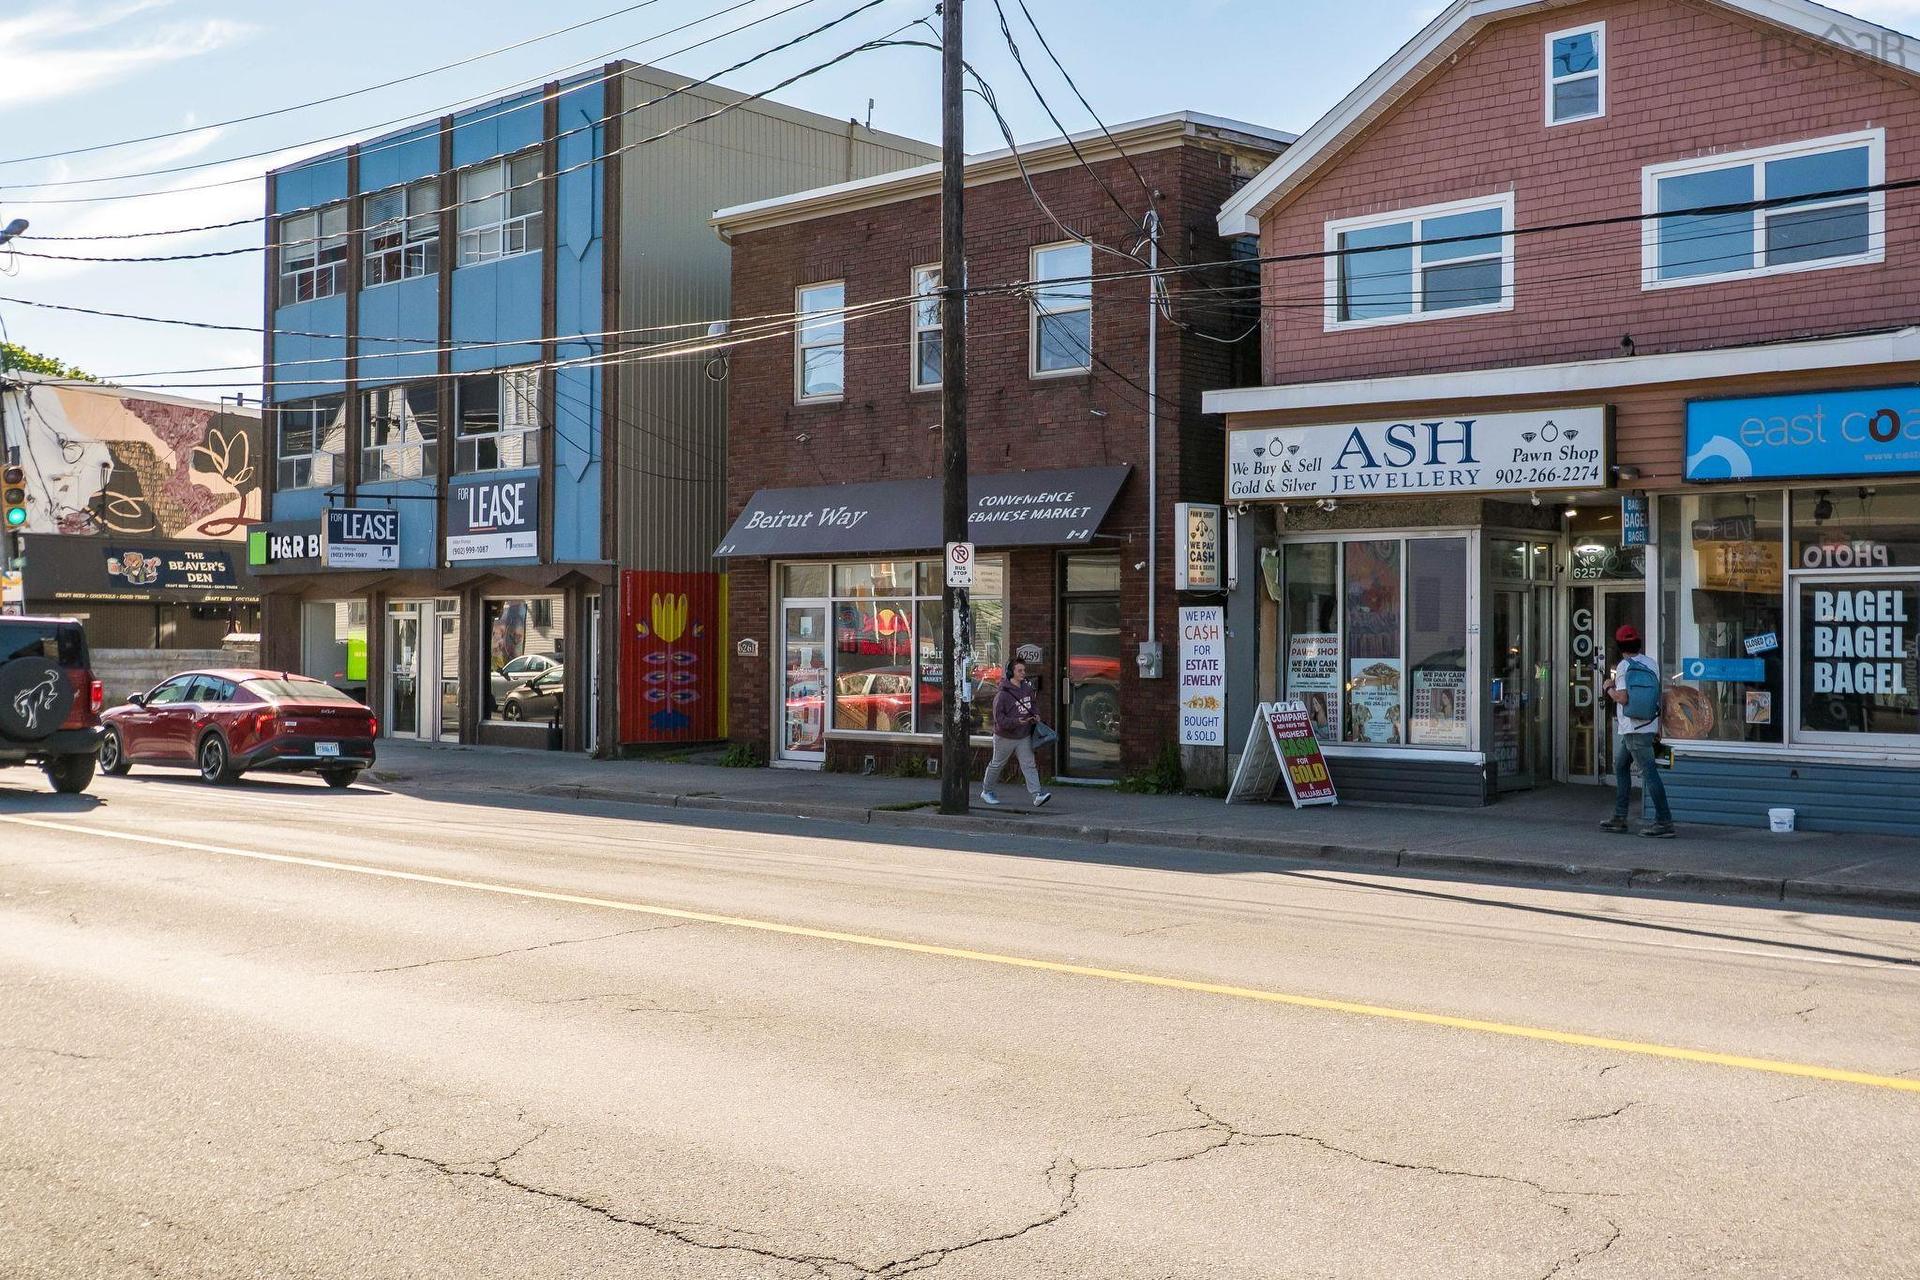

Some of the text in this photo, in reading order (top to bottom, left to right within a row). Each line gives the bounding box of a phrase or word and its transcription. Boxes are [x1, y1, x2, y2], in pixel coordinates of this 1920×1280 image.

[1740, 404, 1826, 446] east
[1331, 420, 1481, 470] ASH
[1512, 445, 1599, 463] Pawn Shop
[1232, 458, 1322, 476] We Buy & Sell
[1331, 469, 1481, 493] JEWELLERY
[1495, 466, 1599, 484] 902-266-2274
[1232, 478, 1317, 494] Gold & Silver
[458, 483, 526, 528] FOR LEASE
[978, 492, 1075, 506] CONVENIENCE
[744, 506, 868, 529] Beirut Way
[968, 507, 1091, 522] EBANESE MARKET
[1625, 514, 1648, 528] BAGEL
[330, 513, 395, 540] FOR LEASE
[1628, 532, 1646, 542] BAGEL
[271, 534, 322, 559] H&R B
[1190, 542, 1214, 550] WE PAY
[184, 552, 204, 560] THE
[168, 561, 226, 572] BEAVER'S
[1574, 568, 1604, 578] 6257
[187, 573, 214, 583] DEN
[1814, 590, 1908, 622] BAGEL
[1186, 610, 1216, 621] WE PAY
[1746, 637, 1764, 648] CLOSED
[1814, 626, 1908, 658] BAGEL
[1019, 651, 1039, 661] 6259
[1194, 645, 1210, 655] FOR
[1186, 659, 1219, 670] ESTATE
[1573, 608, 1593, 707] GOLD
[1182, 675, 1222, 686] JEWELRY
[1814, 662, 1908, 694] BAGEL
[1184, 716, 1219, 726] BOUGHT
[1270, 712, 1308, 722] COMPARE
[1186, 730, 1216, 741] & SOLD
[1279, 730, 1308, 738] HIGHEST
[1289, 762, 1326, 784] GOLD
[1298, 788, 1331, 798] VALUABLES
